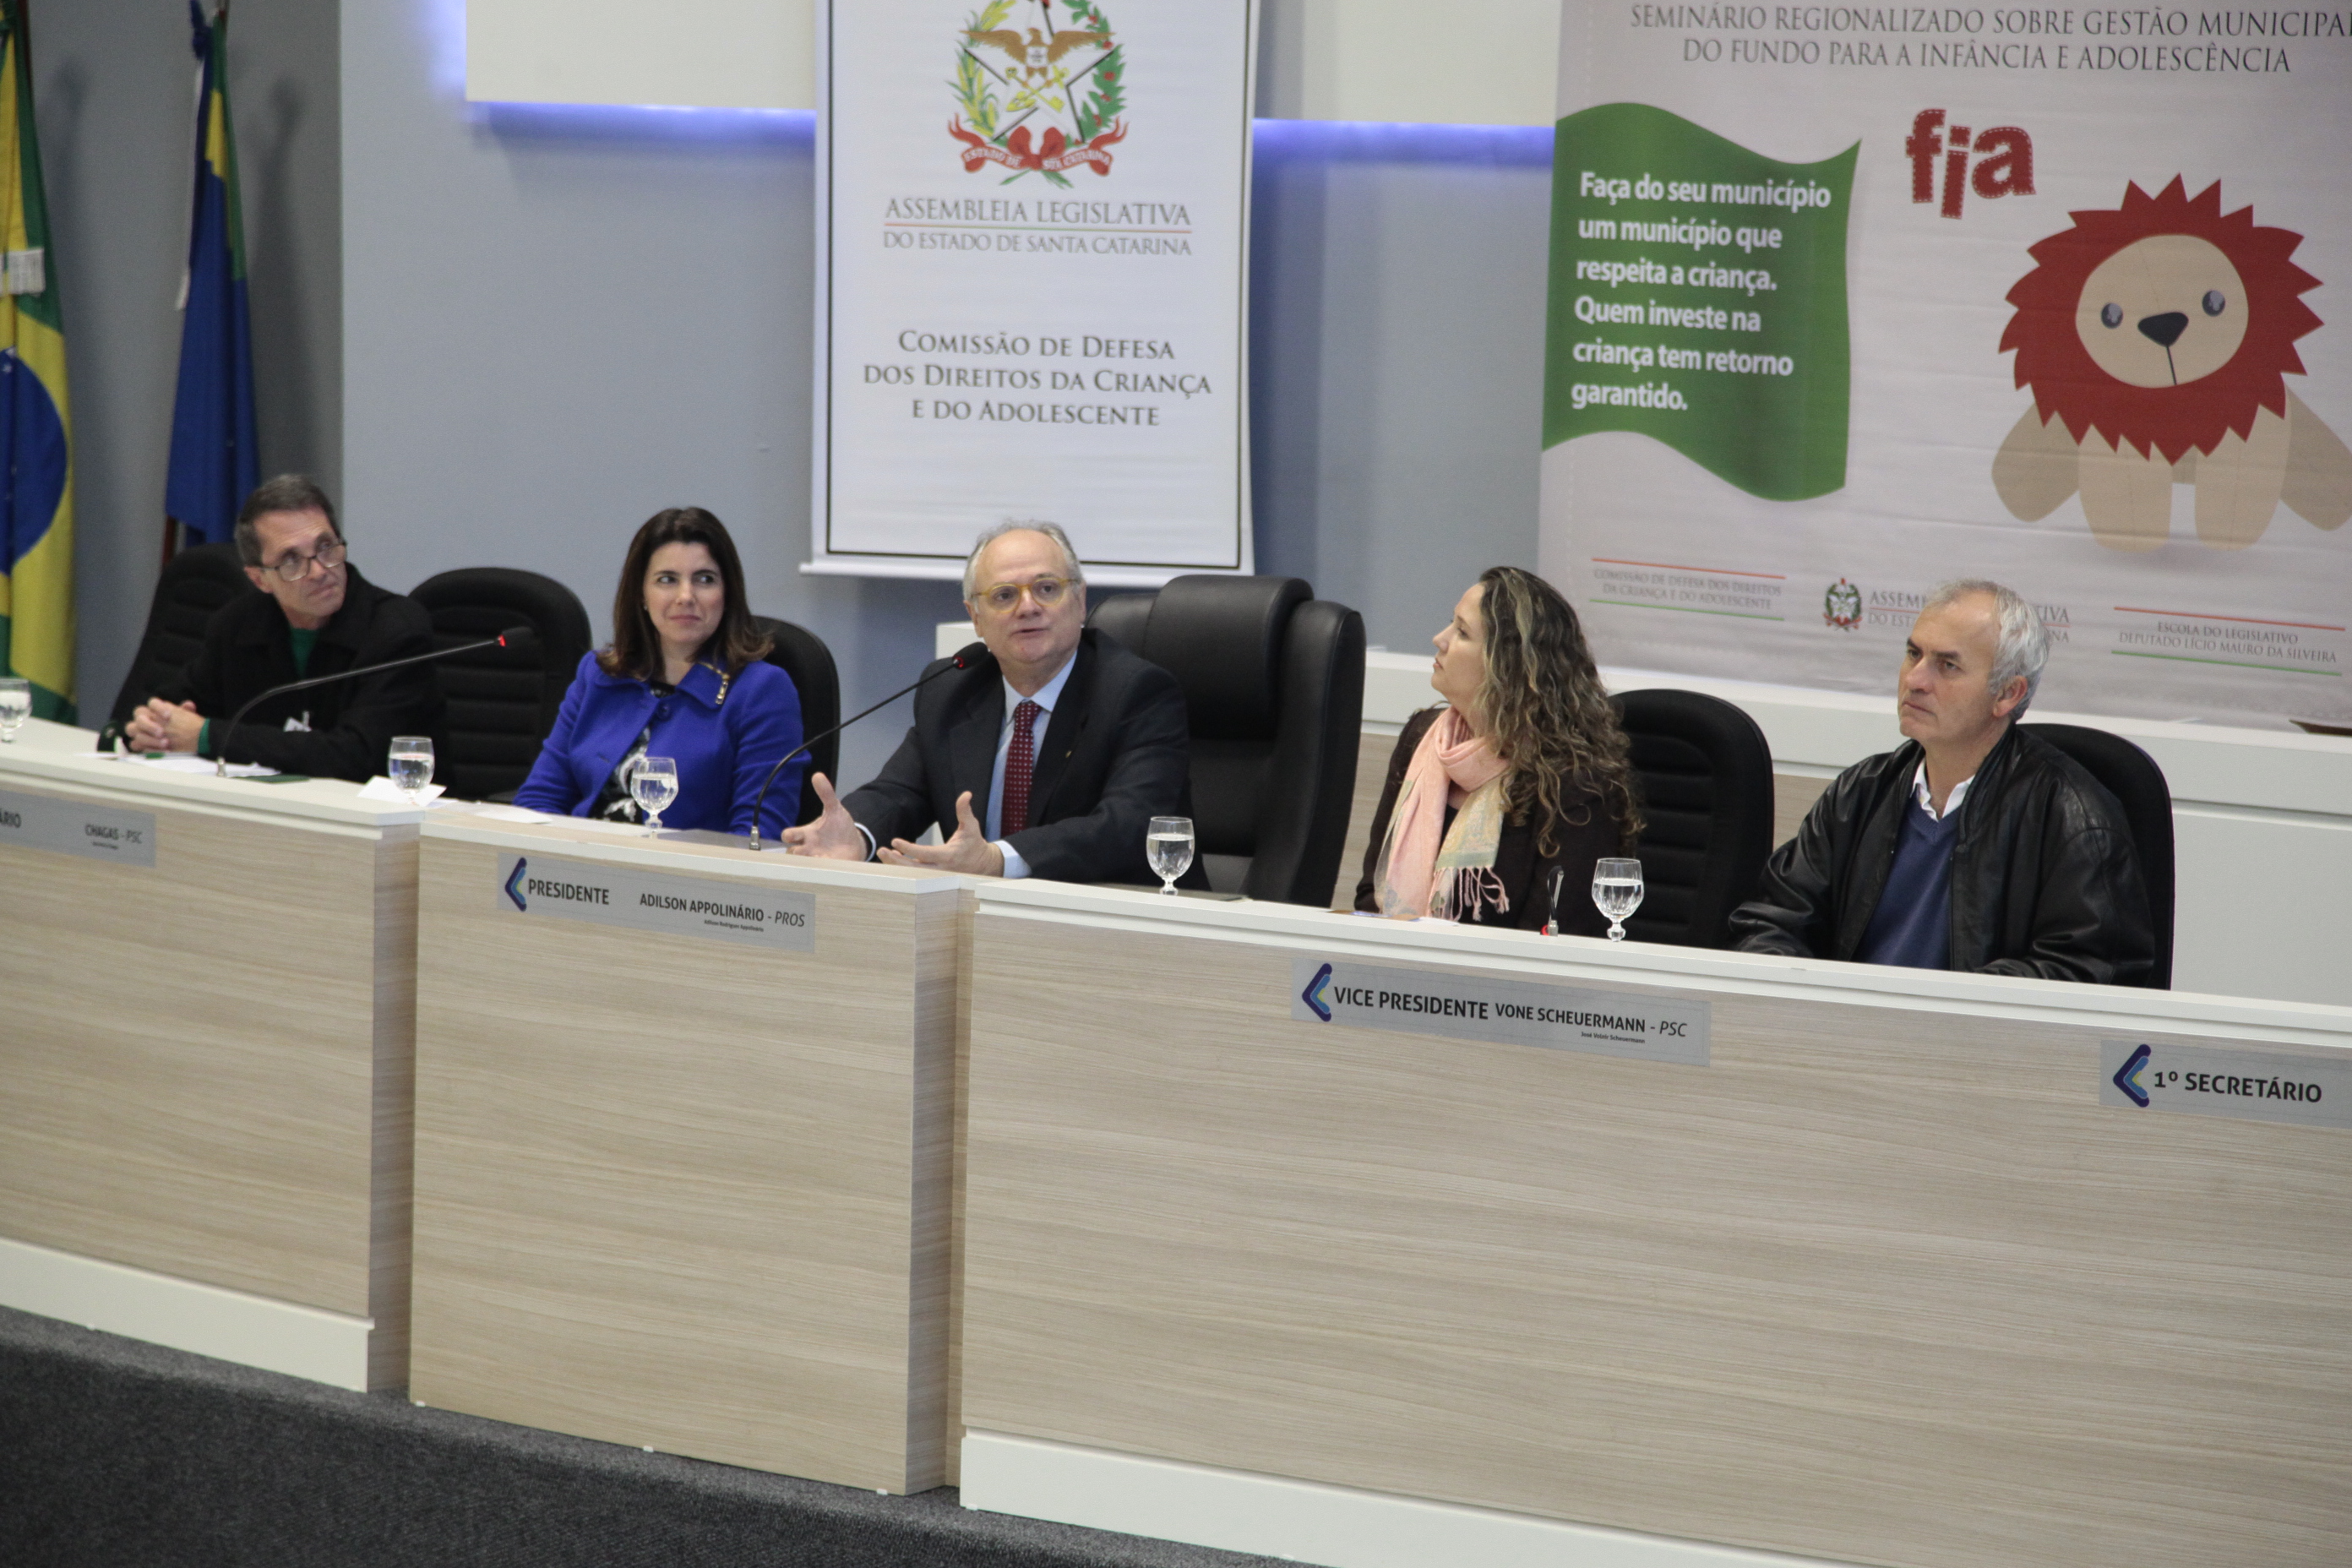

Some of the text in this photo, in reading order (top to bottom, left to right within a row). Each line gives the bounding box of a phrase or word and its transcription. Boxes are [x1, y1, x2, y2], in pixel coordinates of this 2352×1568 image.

[1631, 2, 1767, 30] SEMINÁRIO
[1775, 6, 1984, 34] REGIONALIZADO
[1992, 9, 2073, 35] SOBRE
[2083, 7, 2188, 36] GESTÃO
[1683, 38, 2291, 73] DO FUNDO PARA A INFÂNCIA E ADOLESCÊNCIA
[1580, 172, 1832, 214] Faça do seu município
[885, 198, 1192, 226] ASSEMBLEIA LEGISLATIVA
[883, 231, 1193, 256] DO ESTADO DE SANTA CATARINA
[1578, 216, 1783, 254] um município que
[1576, 257, 1778, 297] respeita a criança.
[1575, 295, 1761, 332] Quem investe na
[898, 329, 1176, 360] COMISSÃO DE DEFESA
[1573, 337, 1794, 377] criança tem retorno
[863, 363, 1213, 400] DOS DIREITOS DA CRIANÇA
[1571, 382, 1689, 411] garantido.
[912, 399, 1161, 427] E DO ADOLESCENTE
[1868, 611, 1888, 625] DO
[2158, 621, 2299, 645] ESCOLA DO LEGISLATIVO
[2119, 631, 2337, 663] DEPUTADO LÍCIO MAURO DA SILVEIRA
[528, 878, 611, 906] PRESIDENTE
[640, 892, 688, 912] ADILSON
[689, 896, 765, 923] APPOLINÁRIO
[775, 910, 806, 928] PROS
[1333, 986, 1375, 1007] VICE
[1378, 990, 1489, 1021] PRESIDENTE
[1495, 1002, 1534, 1021] VONE
[1537, 1008, 1647, 1033] SCHEUERMANN
[1659, 1021, 1688, 1038] PSC
[1581, 1031, 1592, 1039] José
[1609, 1034, 1647, 1045] Scheuermann
[2154, 1070, 2322, 1103] 1º SECRETÁRIO
